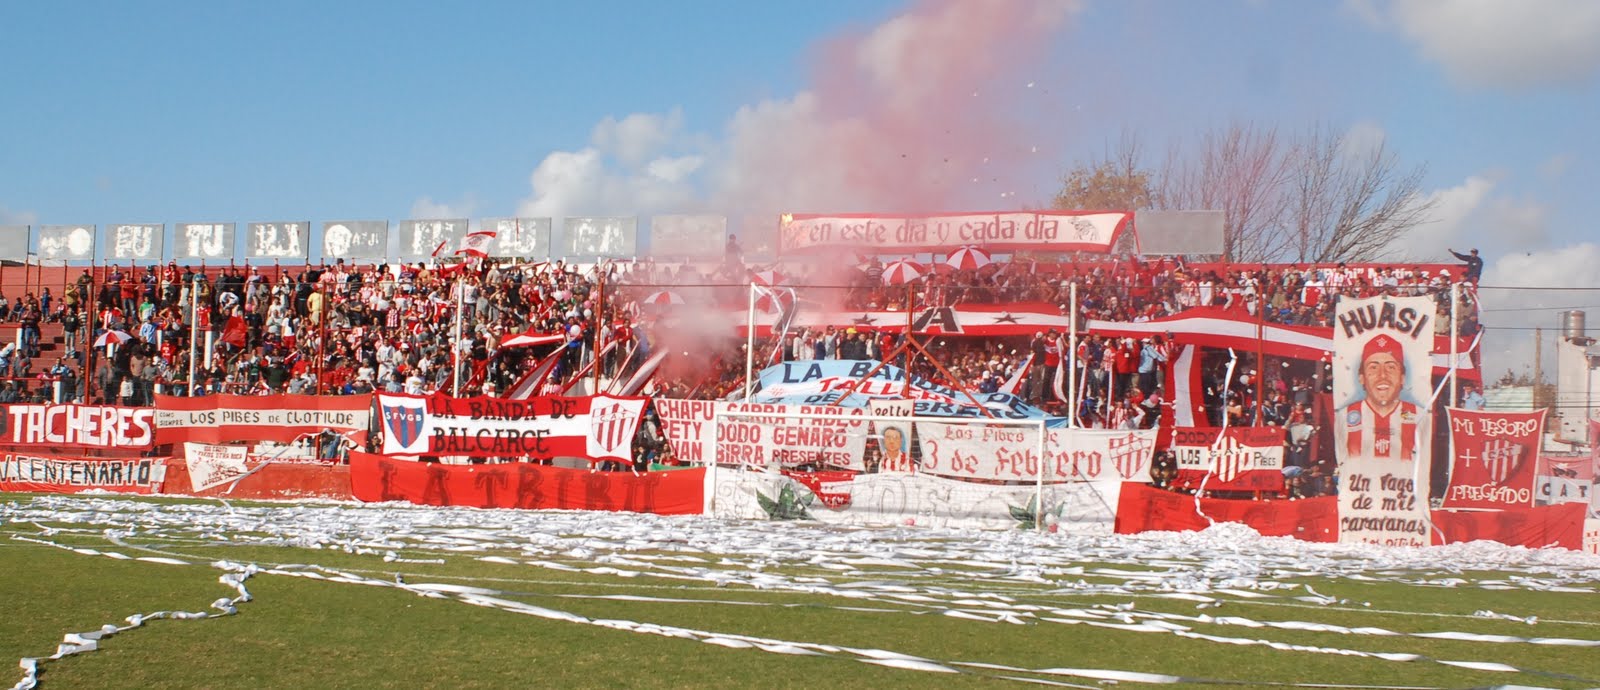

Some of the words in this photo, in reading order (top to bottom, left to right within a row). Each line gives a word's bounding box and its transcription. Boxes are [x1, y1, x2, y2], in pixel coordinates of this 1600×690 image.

[809, 223, 832, 241] en
[841, 220, 886, 243] este
[958, 214, 1015, 241] cada
[1338, 302, 1429, 340] HUASI
[782, 362, 823, 383] LA
[190, 412, 216, 425] LOS
[223, 411, 260, 424] PIBES
[269, 415, 280, 424] DE
[286, 412, 354, 426] CLOTILDE
[431, 398, 457, 420] LA
[469, 400, 537, 421] BANDA
[550, 399, 577, 419] DE
[657, 400, 714, 421] CHAPU
[9, 405, 153, 446] TACHERES
[1453, 418, 1475, 437] MI
[1479, 418, 1538, 438] TESORO
[432, 427, 551, 453] BALCARCE
[773, 426, 847, 448] GENARO
[717, 443, 764, 465] BIRRA
[772, 449, 851, 467] PRESENTES
[924, 440, 939, 471] 3
[951, 449, 979, 475] de
[1181, 449, 1200, 465] LOS
[1349, 474, 1371, 492] Un
[1352, 494, 1373, 510] de
[1381, 494, 1415, 511] mil
[1341, 516, 1426, 535] caravanas
